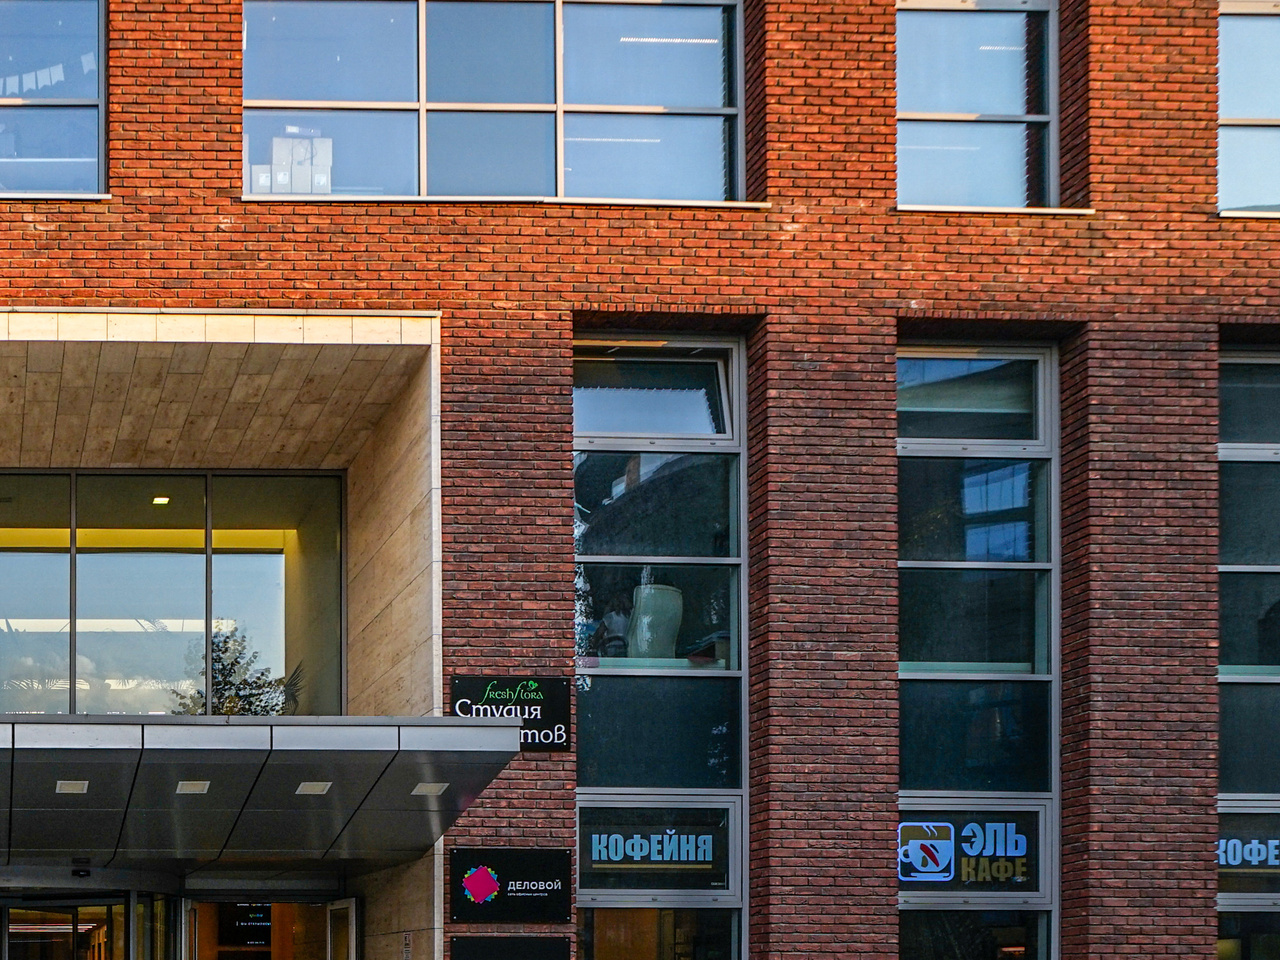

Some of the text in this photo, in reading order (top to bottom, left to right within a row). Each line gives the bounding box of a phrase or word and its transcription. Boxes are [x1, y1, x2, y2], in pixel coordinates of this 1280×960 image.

[591, 829, 713, 862] КОФЕЙНЯ
[961, 822, 1027, 857] ЭЛЬ
[961, 857, 1027, 882] КАФЕ
[507, 879, 562, 891] ДЕЛОВОЙ
